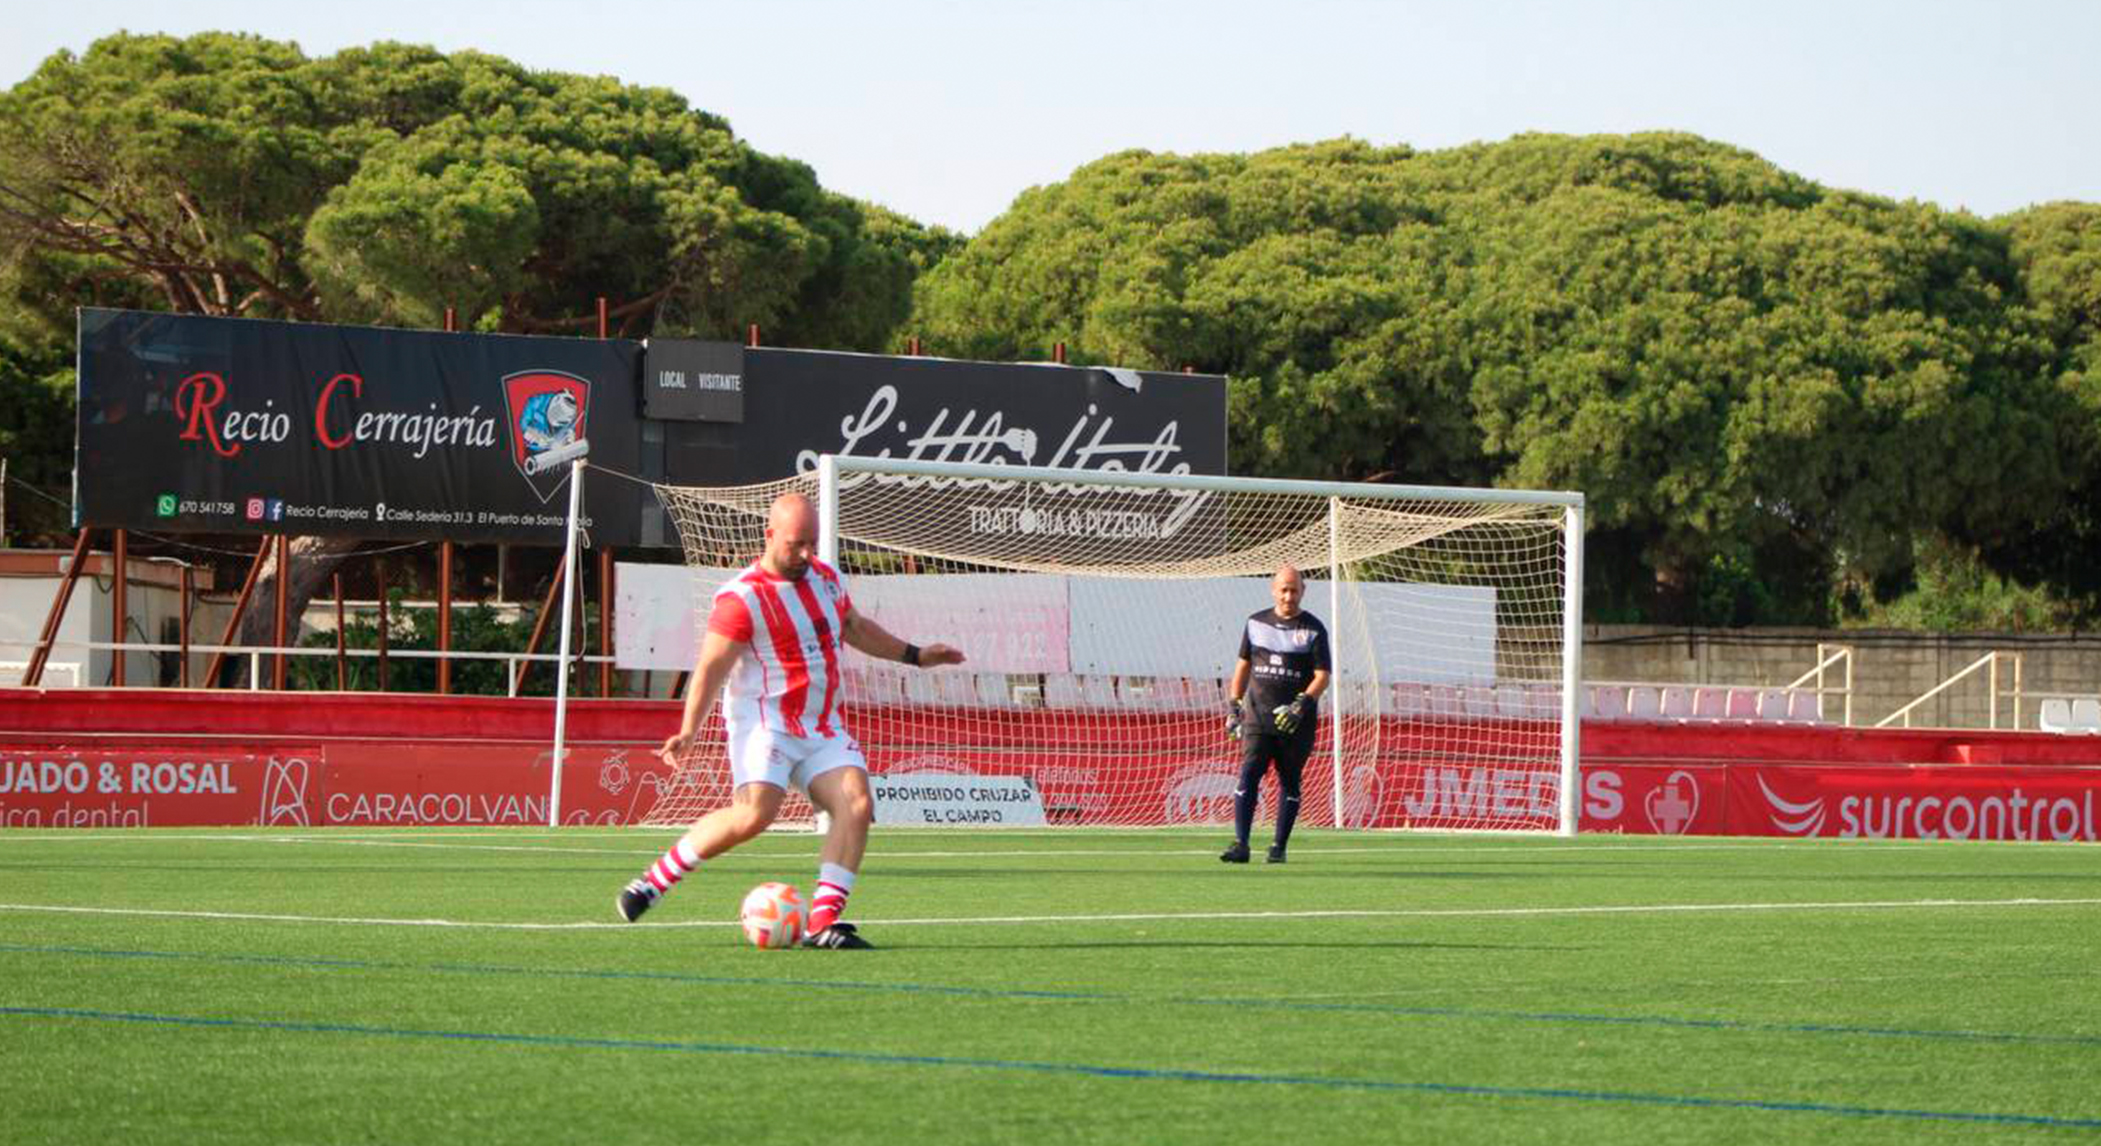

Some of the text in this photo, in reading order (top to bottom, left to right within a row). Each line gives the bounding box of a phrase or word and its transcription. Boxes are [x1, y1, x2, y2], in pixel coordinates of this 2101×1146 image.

[660, 370, 742, 391] LOCAL VISITANTE
[175, 372, 496, 458] Recio Cerrajería
[286, 504, 315, 518] Recio
[386, 508, 414, 521] Calle
[478, 512, 487, 524] El
[489, 513, 519, 526] Puerto
[521, 513, 534, 526] de
[536, 514, 564, 527] Santa
[1086, 510, 1161, 541] PIZZERIA
[98, 761, 122, 794] &
[131, 762, 237, 794] ROSAL
[876, 786, 966, 801] PROHIBIDO
[969, 788, 1032, 803] CRUZAR
[1404, 768, 1624, 820] JMEDS
[53, 799, 149, 828] dental
[923, 808, 1003, 823] EL CAMPO
[1840, 788, 2096, 841] surcontrol
